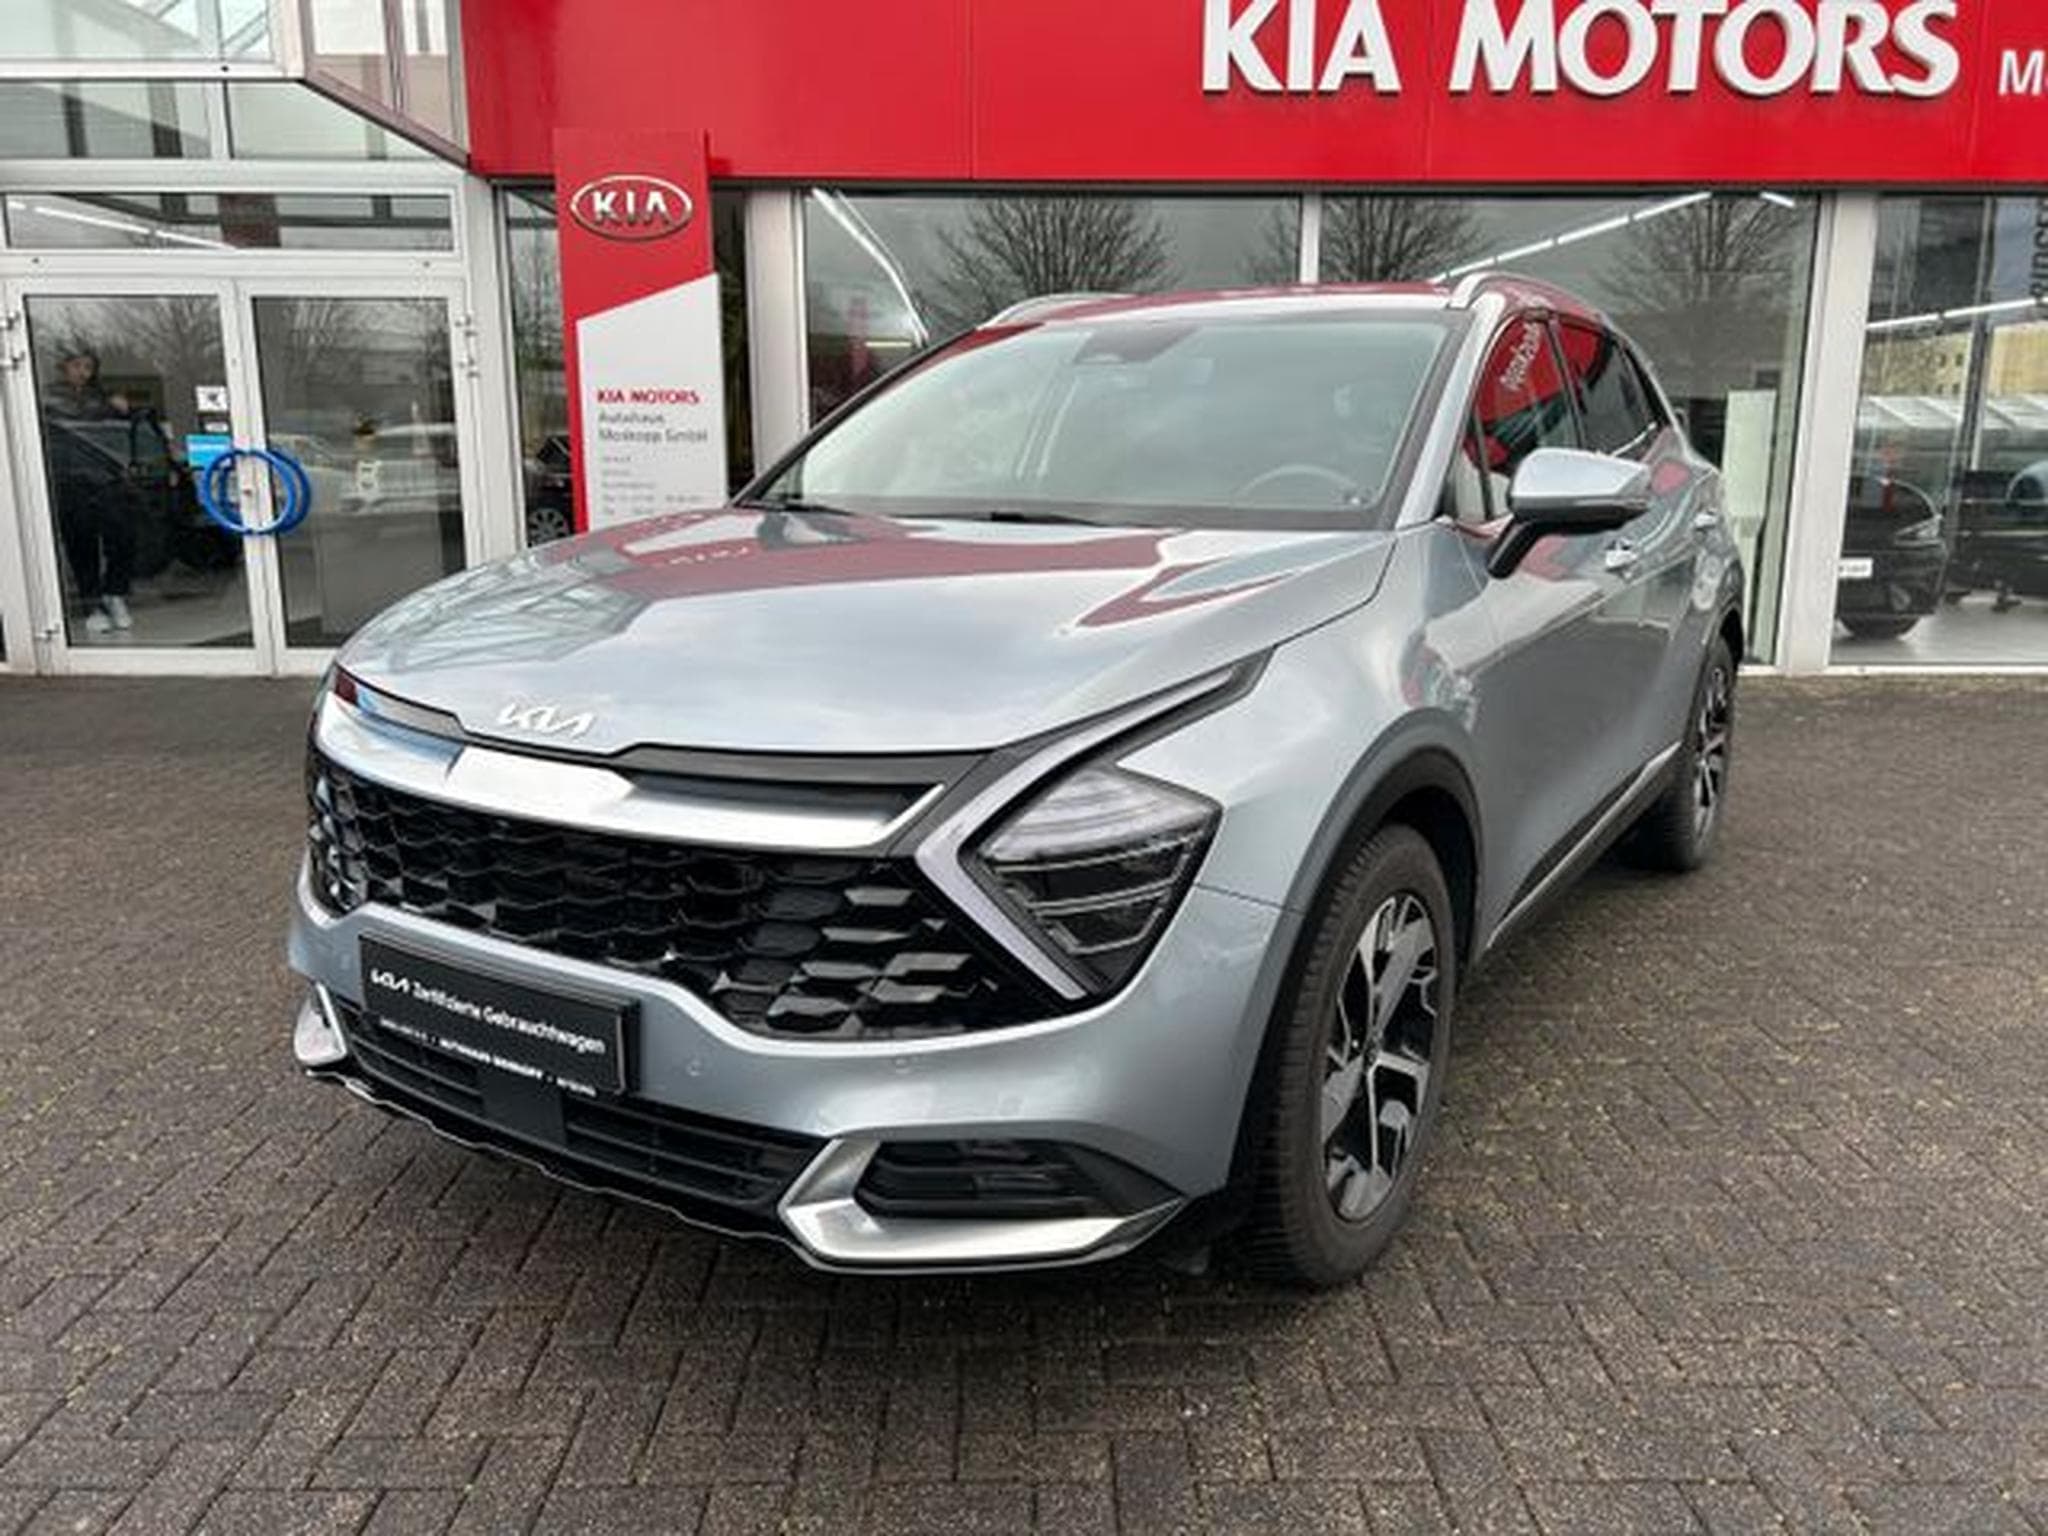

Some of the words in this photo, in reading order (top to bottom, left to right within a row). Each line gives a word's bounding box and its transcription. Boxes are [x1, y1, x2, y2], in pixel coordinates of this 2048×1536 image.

[1202, 0, 1402, 94] KIA
[1448, 0, 1961, 97] MOTORS
[1998, 49, 2048, 95] M
[591, 190, 674, 225] KIA
[597, 389, 625, 403] KIA
[630, 389, 699, 404] MOTORS
